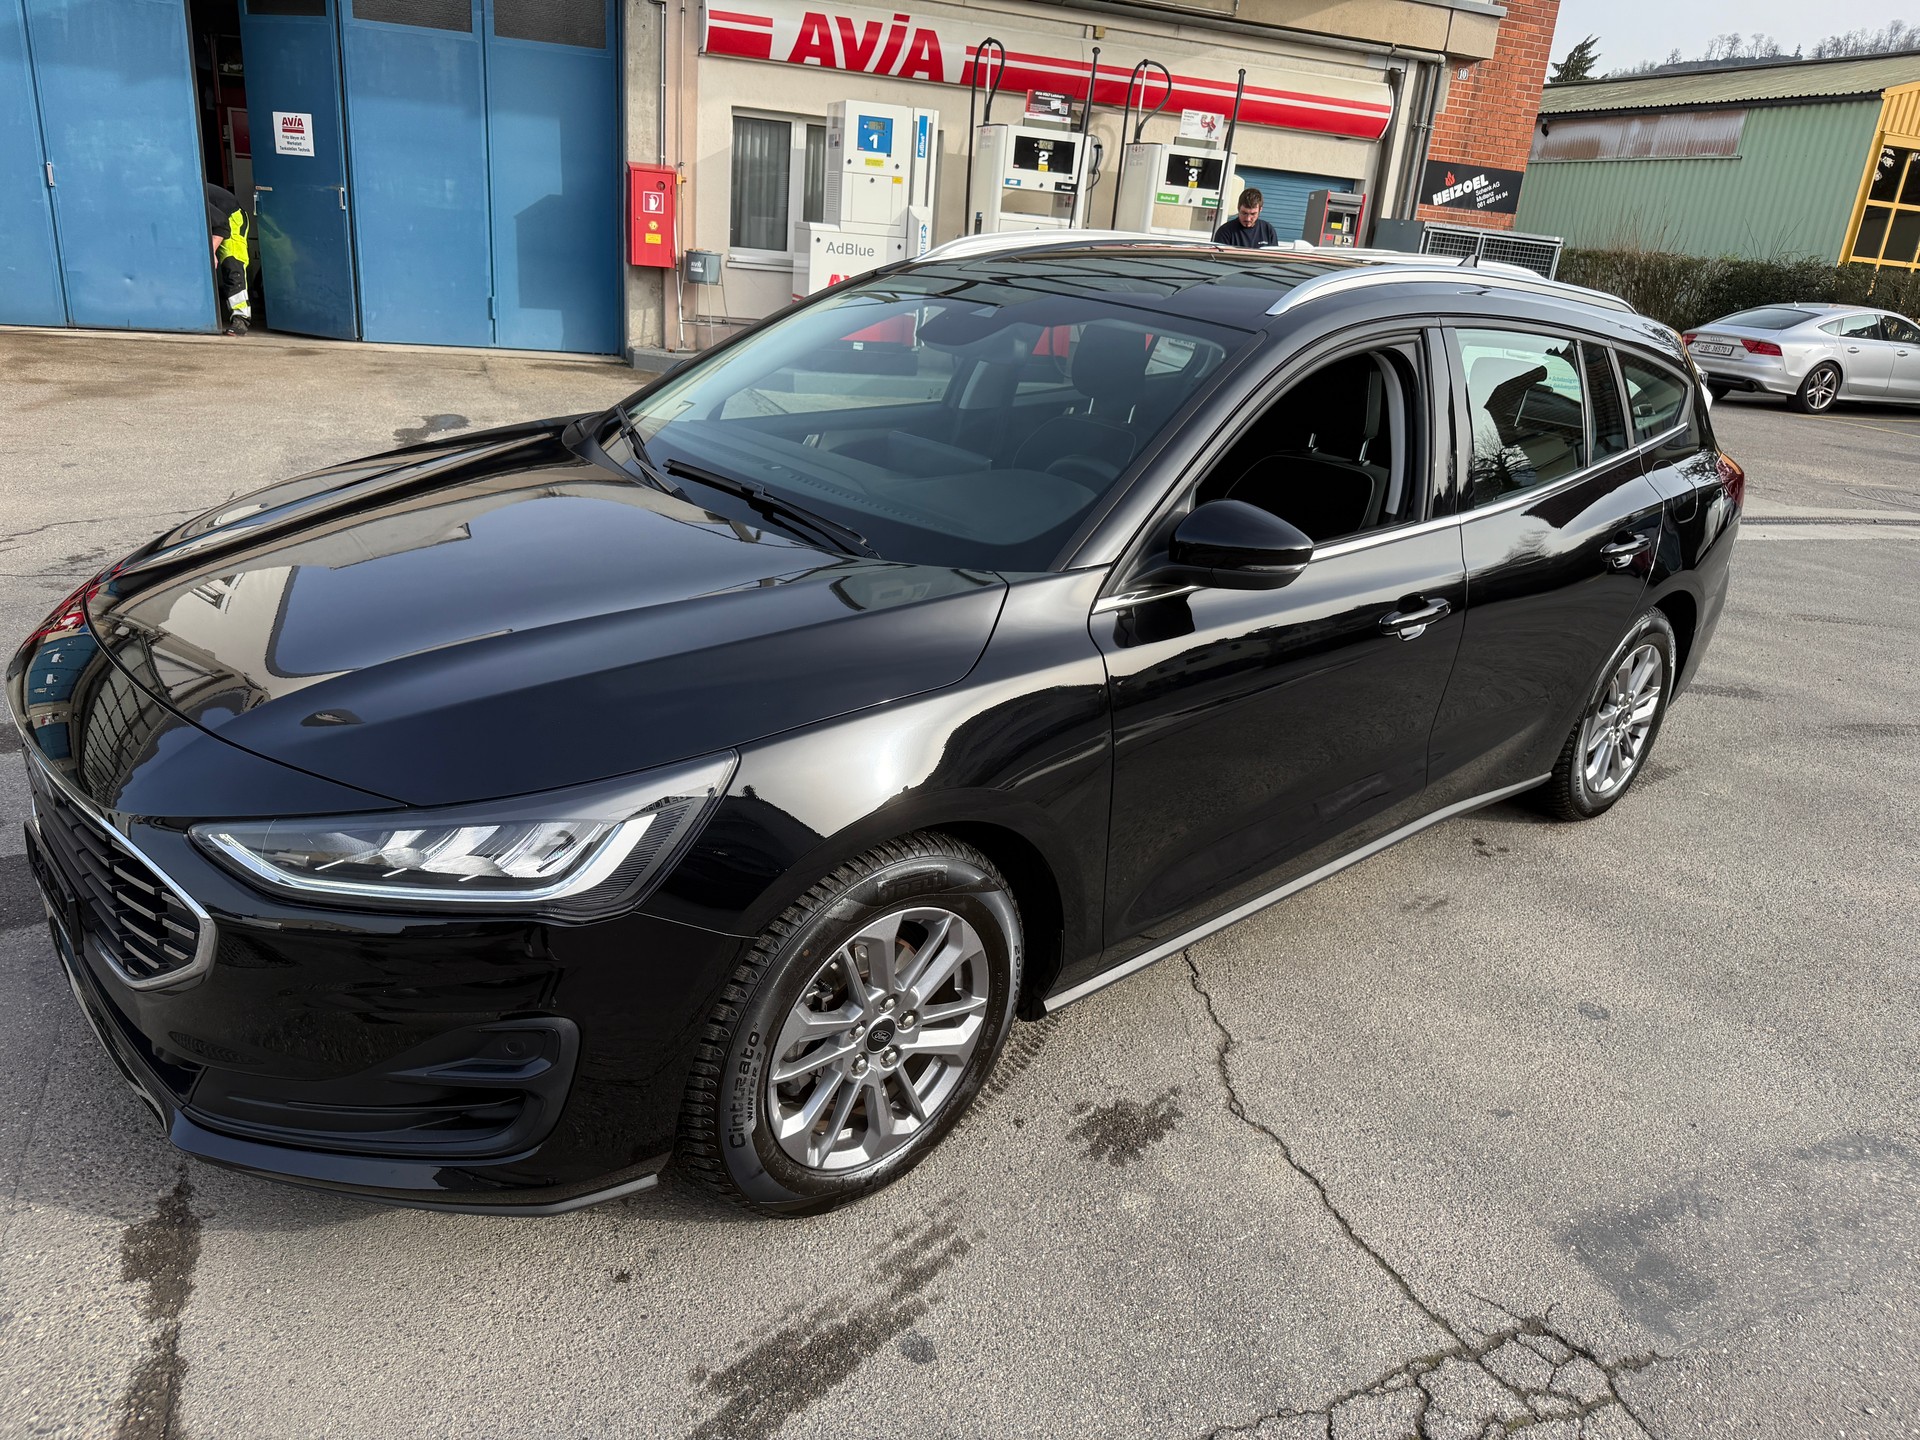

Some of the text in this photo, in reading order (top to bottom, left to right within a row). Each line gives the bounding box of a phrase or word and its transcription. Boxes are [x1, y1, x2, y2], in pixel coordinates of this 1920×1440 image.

[787, 12, 945, 82] AVIA
[282, 115, 304, 127] AVIA
[869, 134, 878, 149] 1
[1038, 150, 1049, 165] 2
[1188, 168, 1198, 182] 3
[1432, 174, 1489, 206] HEIZOEL
[1475, 181, 1501, 196] Schenk AG
[826, 242, 875, 257] AdBlue
[747, 1066, 759, 1122] WINTER
